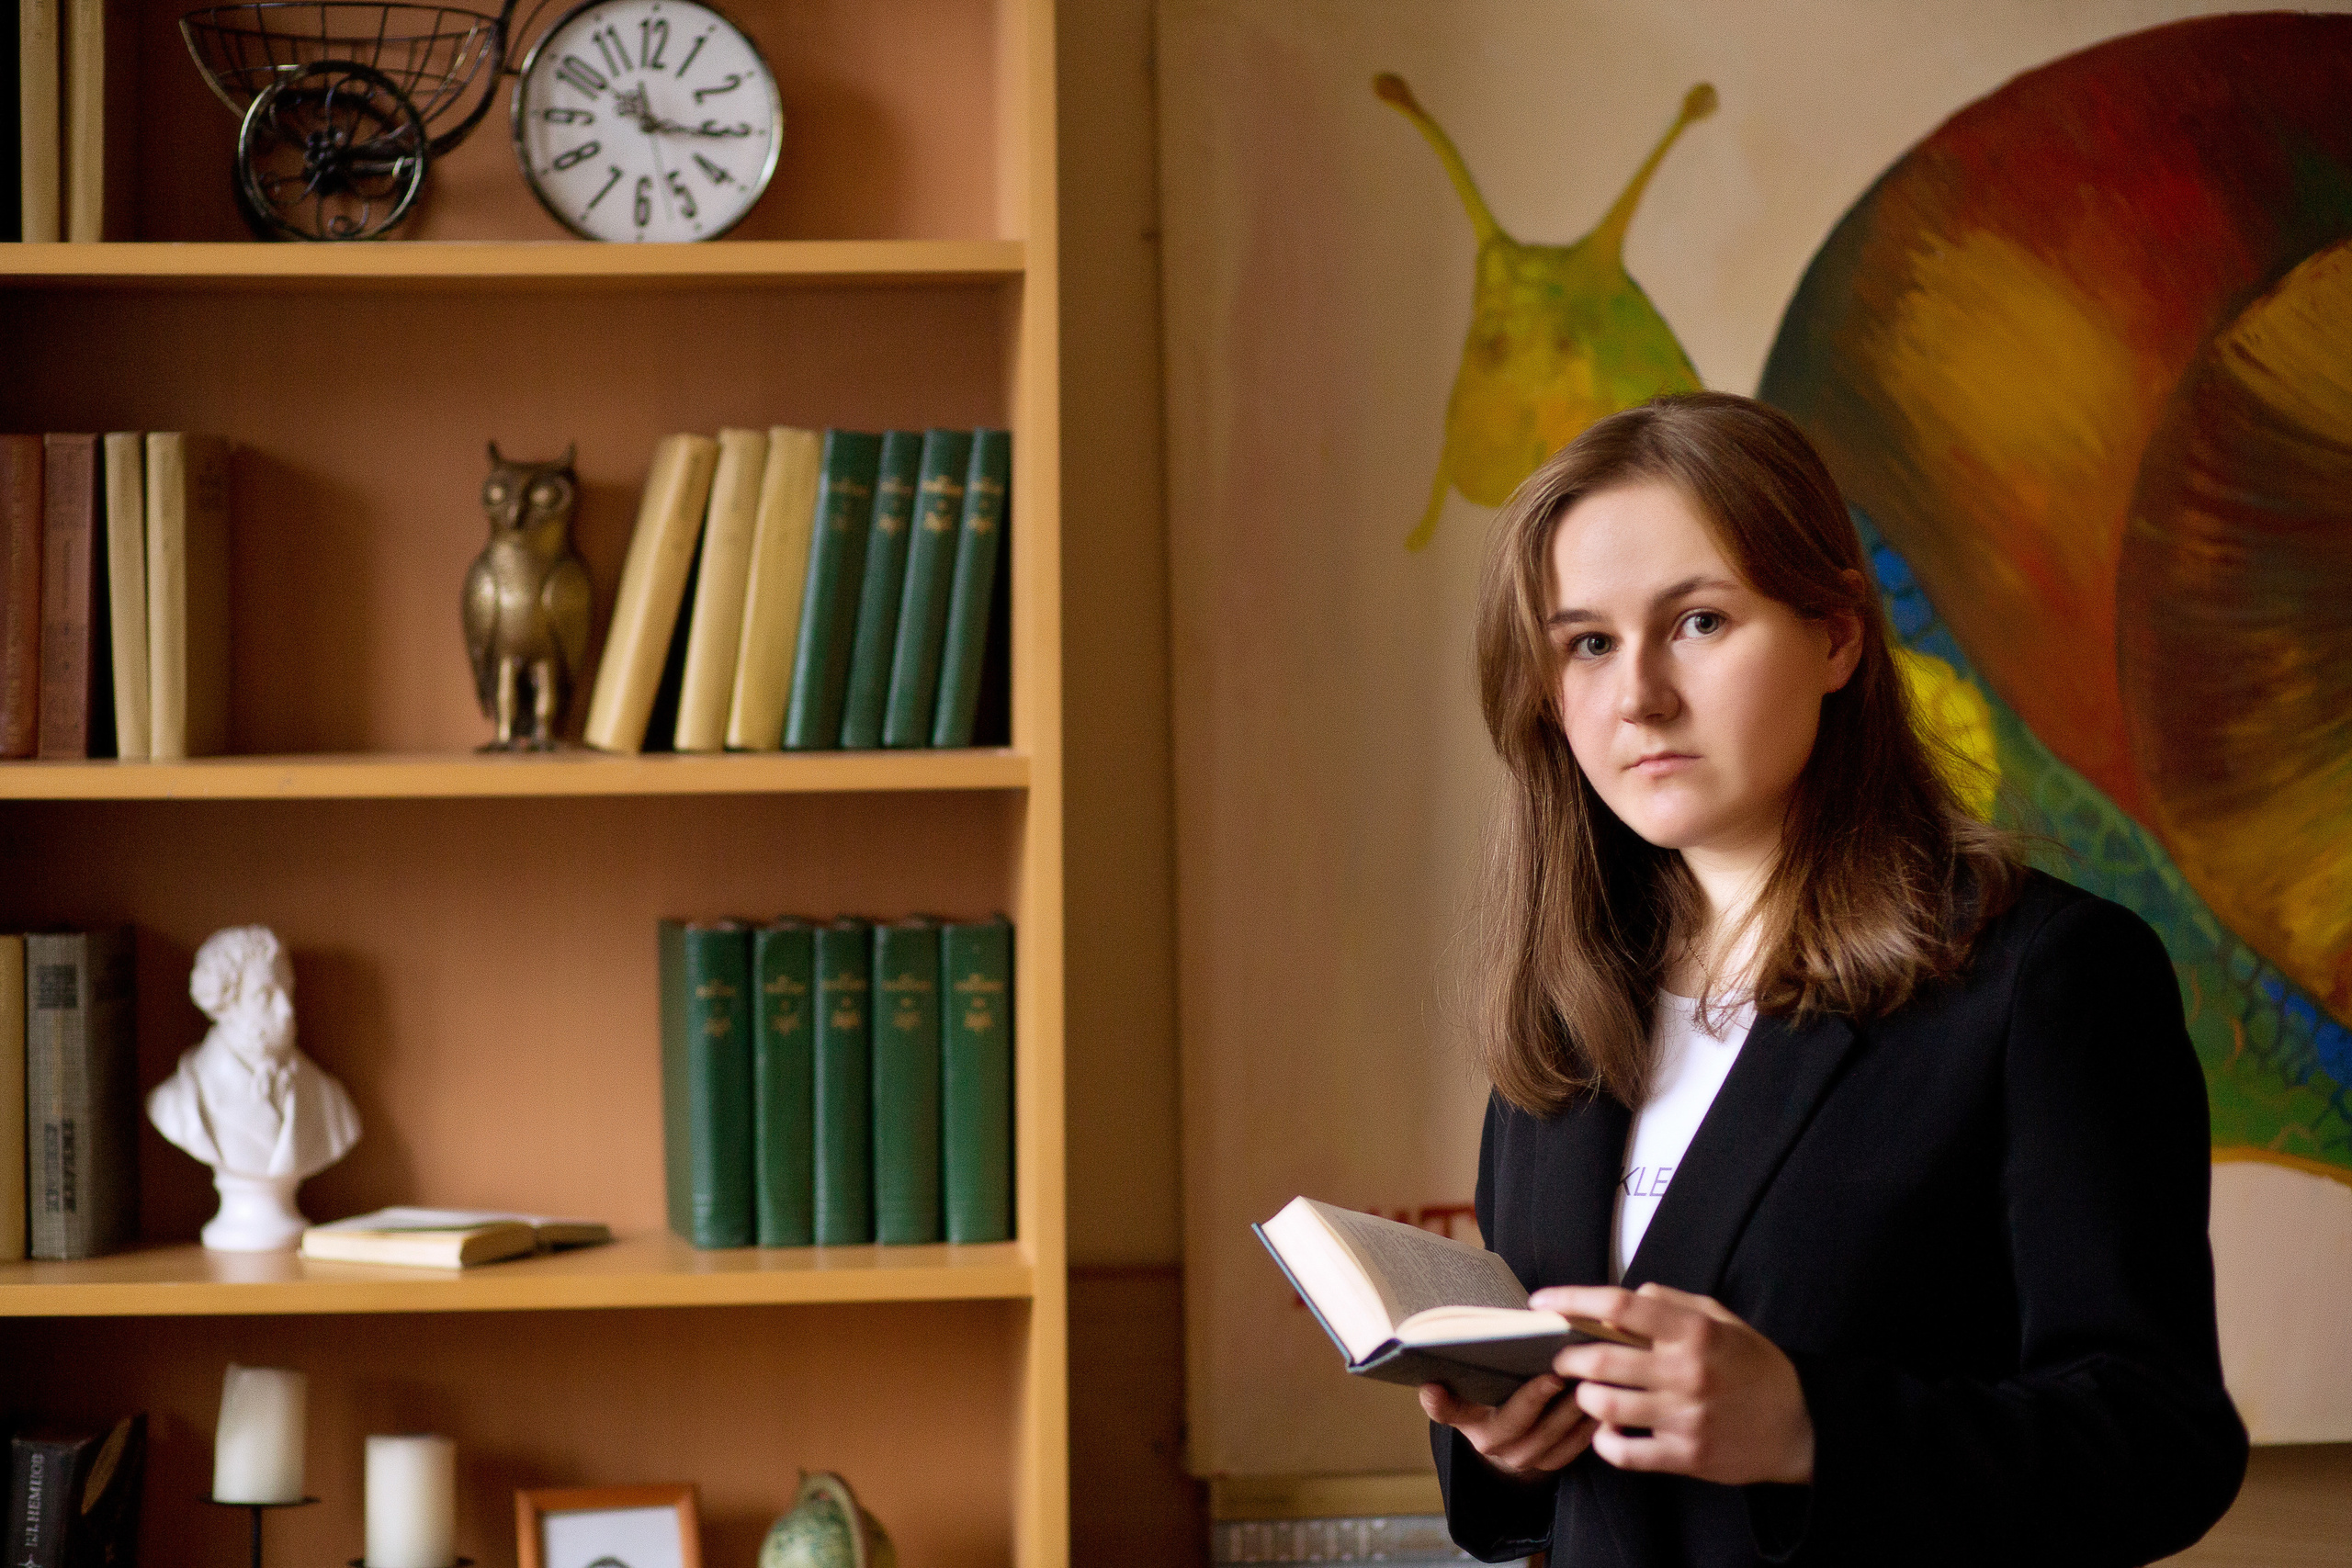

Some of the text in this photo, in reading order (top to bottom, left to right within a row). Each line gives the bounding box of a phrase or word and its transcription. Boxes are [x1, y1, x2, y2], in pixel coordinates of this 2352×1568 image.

[592, 25, 634, 78] 11
[639, 17, 670, 69] 12
[675, 35, 707, 79] 1
[556, 55, 608, 101] 10
[694, 73, 741, 105] 2
[543, 108, 595, 126] 9
[700, 119, 752, 138] 3
[553, 141, 601, 171] 8
[693, 152, 735, 185] 4
[587, 165, 624, 210] 7
[634, 175, 652, 228] 6
[666, 170, 698, 219] 5
